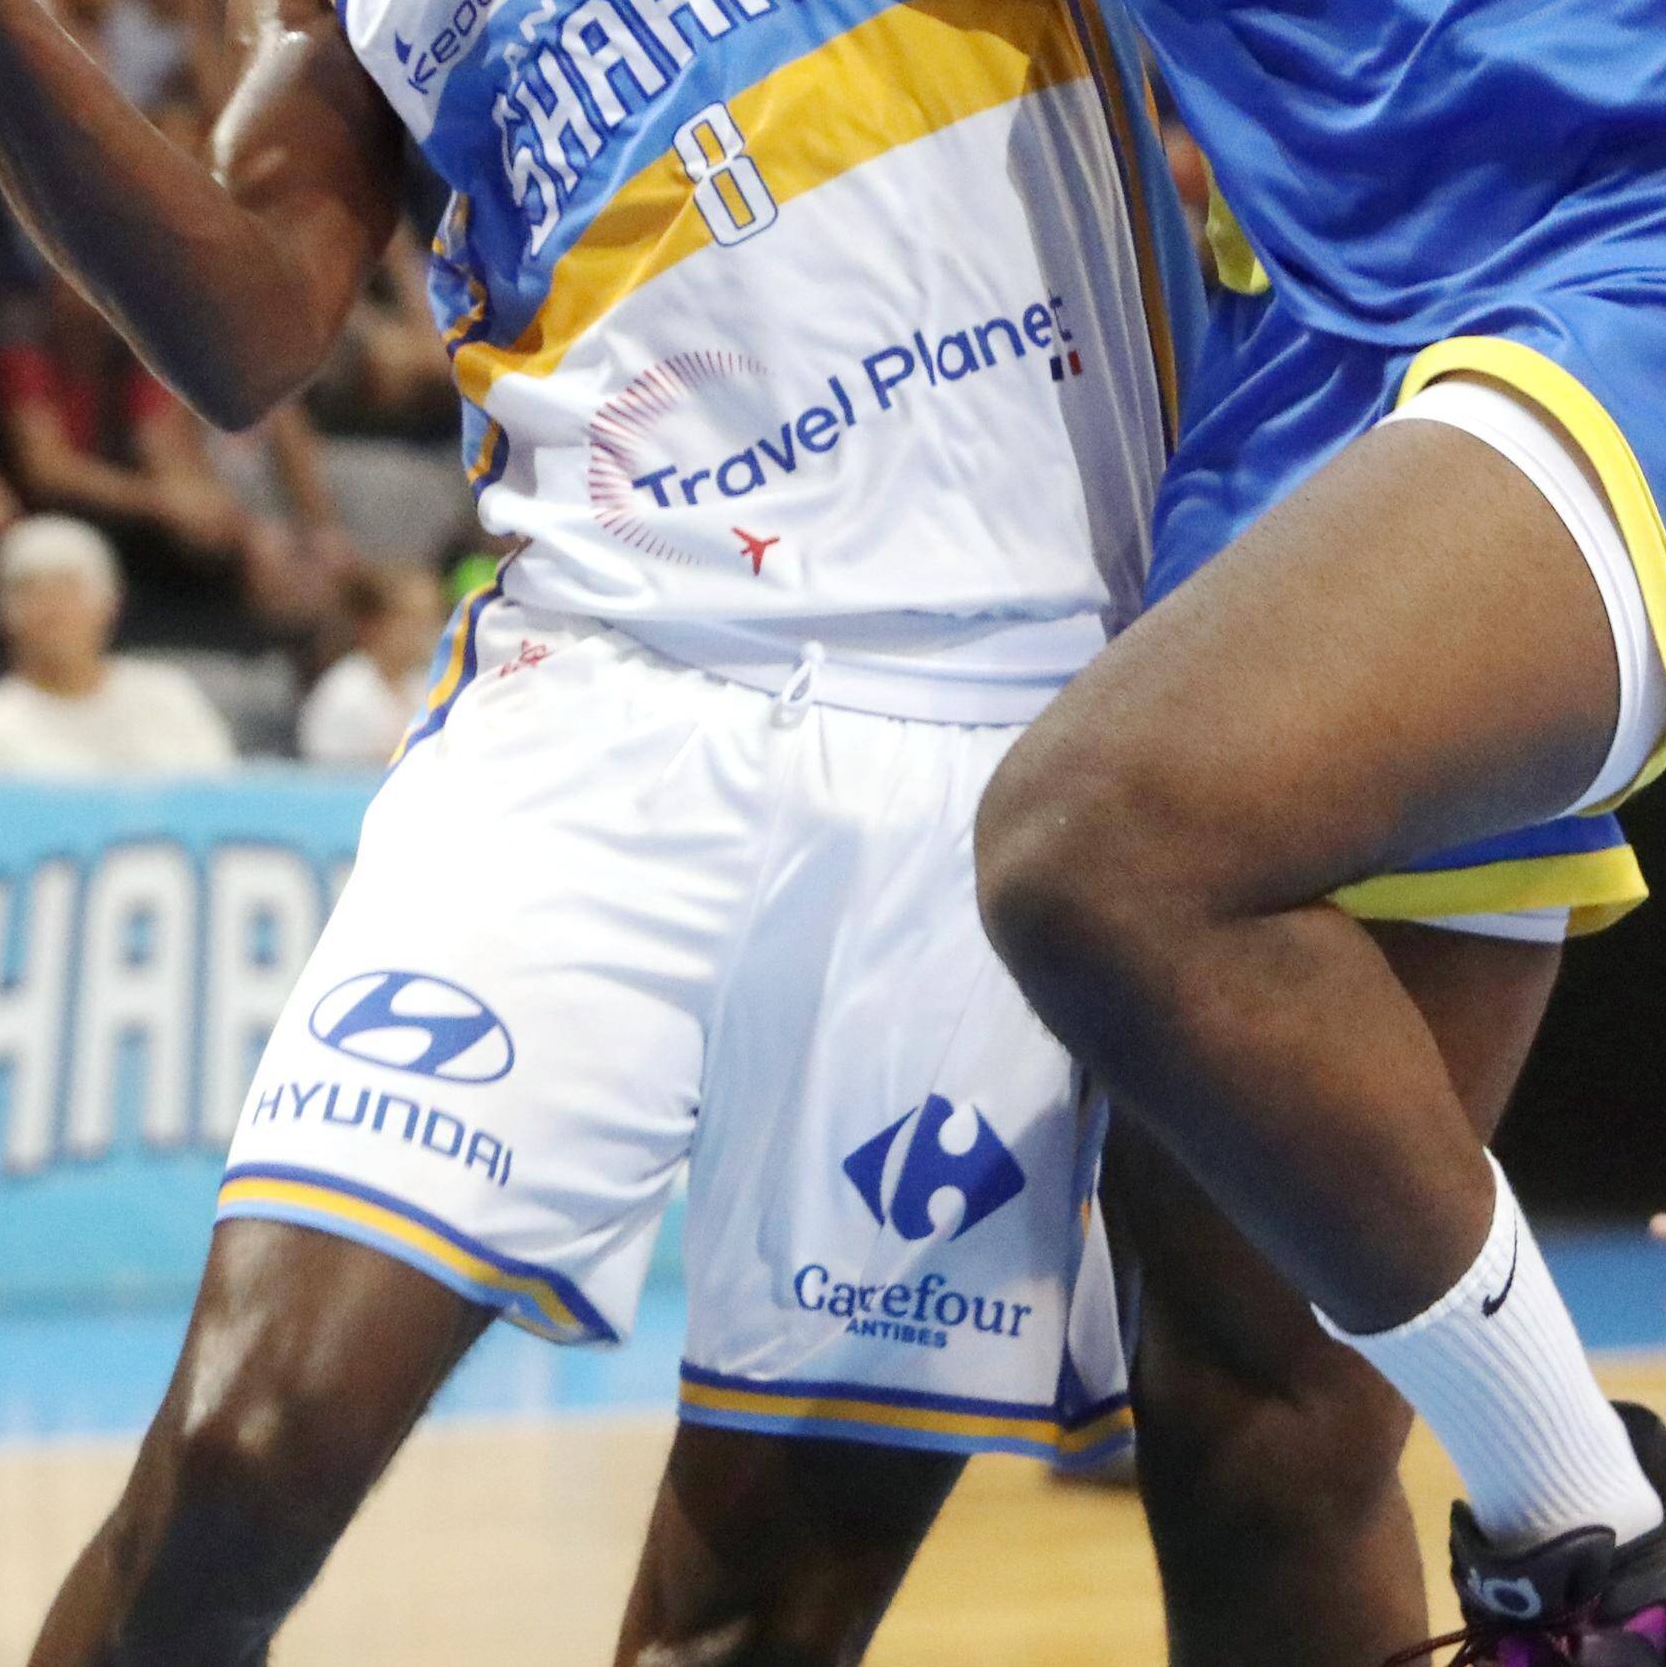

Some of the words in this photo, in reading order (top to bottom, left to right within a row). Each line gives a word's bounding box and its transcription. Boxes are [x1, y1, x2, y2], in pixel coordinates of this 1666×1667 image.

[672, 101, 779, 248] 8
[633, 376, 854, 509] Travel
[252, 1081, 516, 1188] HYUNDAI
[793, 1263, 1032, 1337] Carefour
[845, 1316, 948, 1349] ANTIBES
